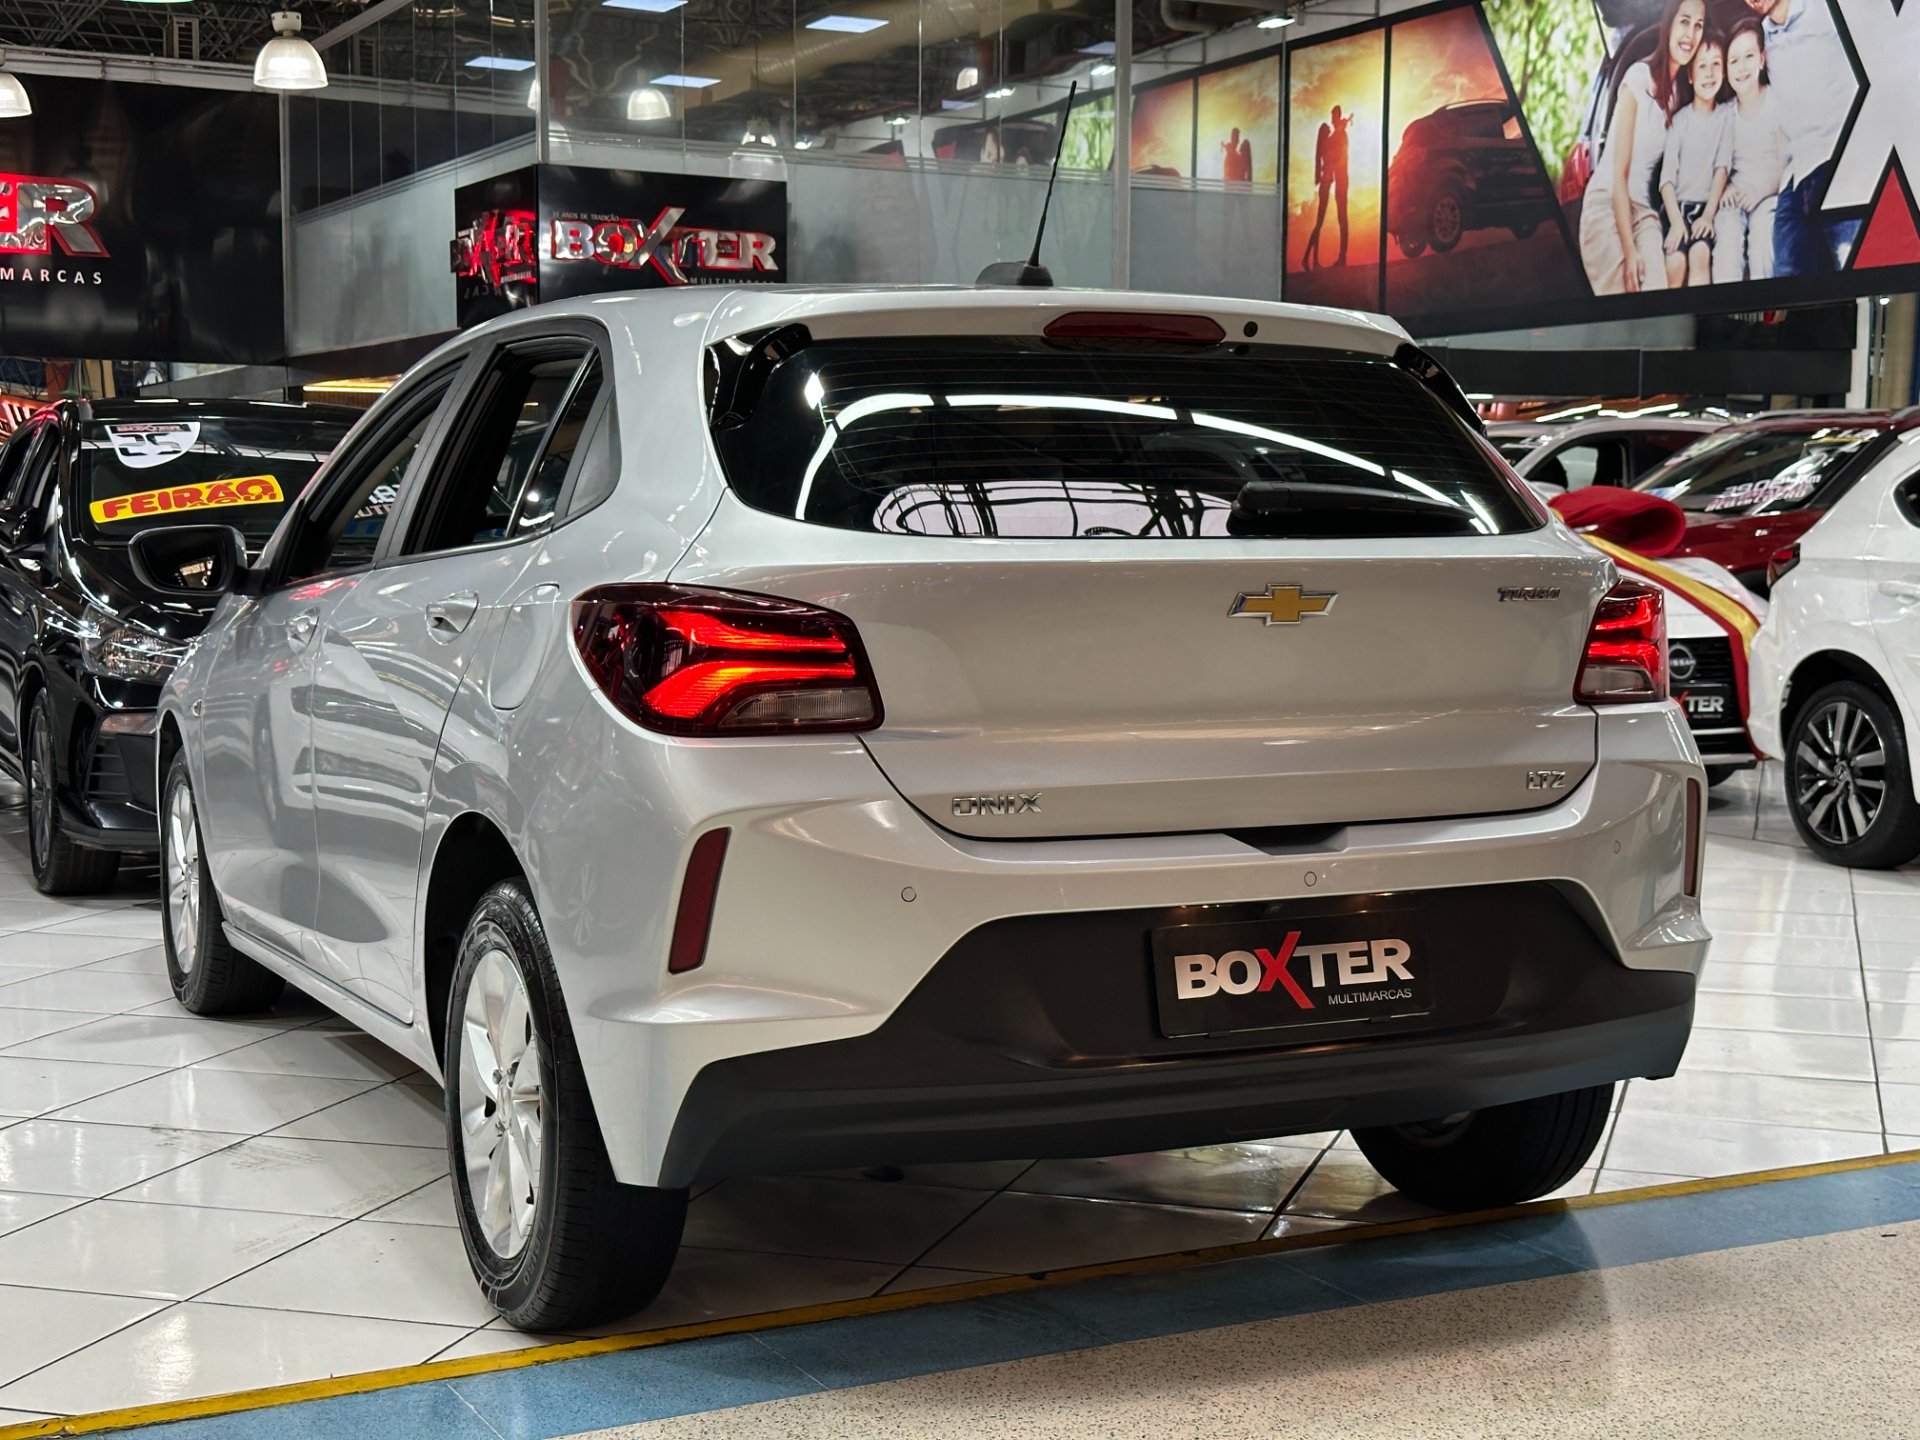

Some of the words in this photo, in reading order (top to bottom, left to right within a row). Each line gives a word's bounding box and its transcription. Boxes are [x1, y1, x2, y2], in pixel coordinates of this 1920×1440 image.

[550, 206, 779, 284] BOXTER
[0, 267, 102, 285] MARCAS
[102, 478, 275, 519] FEIRÃO
[1527, 770, 1566, 789] LTZ
[953, 792, 1042, 816] ONIX
[1174, 931, 1415, 1009] BOXTER
[1327, 988, 1413, 1006] MULTIMARCAS
